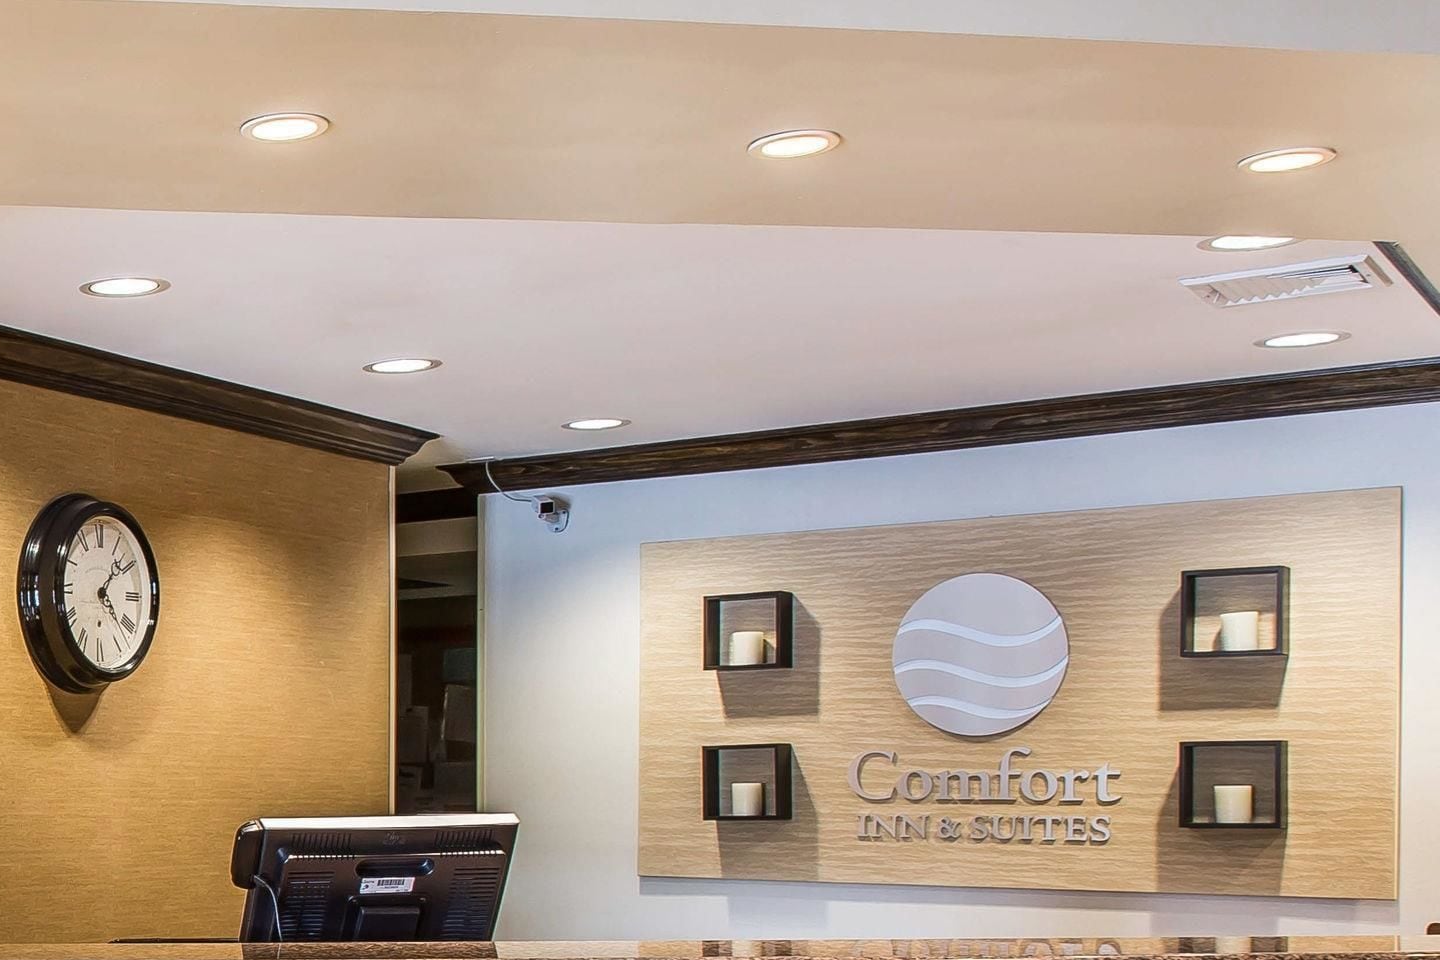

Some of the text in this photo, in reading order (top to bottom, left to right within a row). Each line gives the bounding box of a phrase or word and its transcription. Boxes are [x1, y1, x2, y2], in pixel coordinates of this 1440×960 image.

[848, 746, 1122, 806] Comfort
[857, 814, 1111, 844] INN & SUITES
